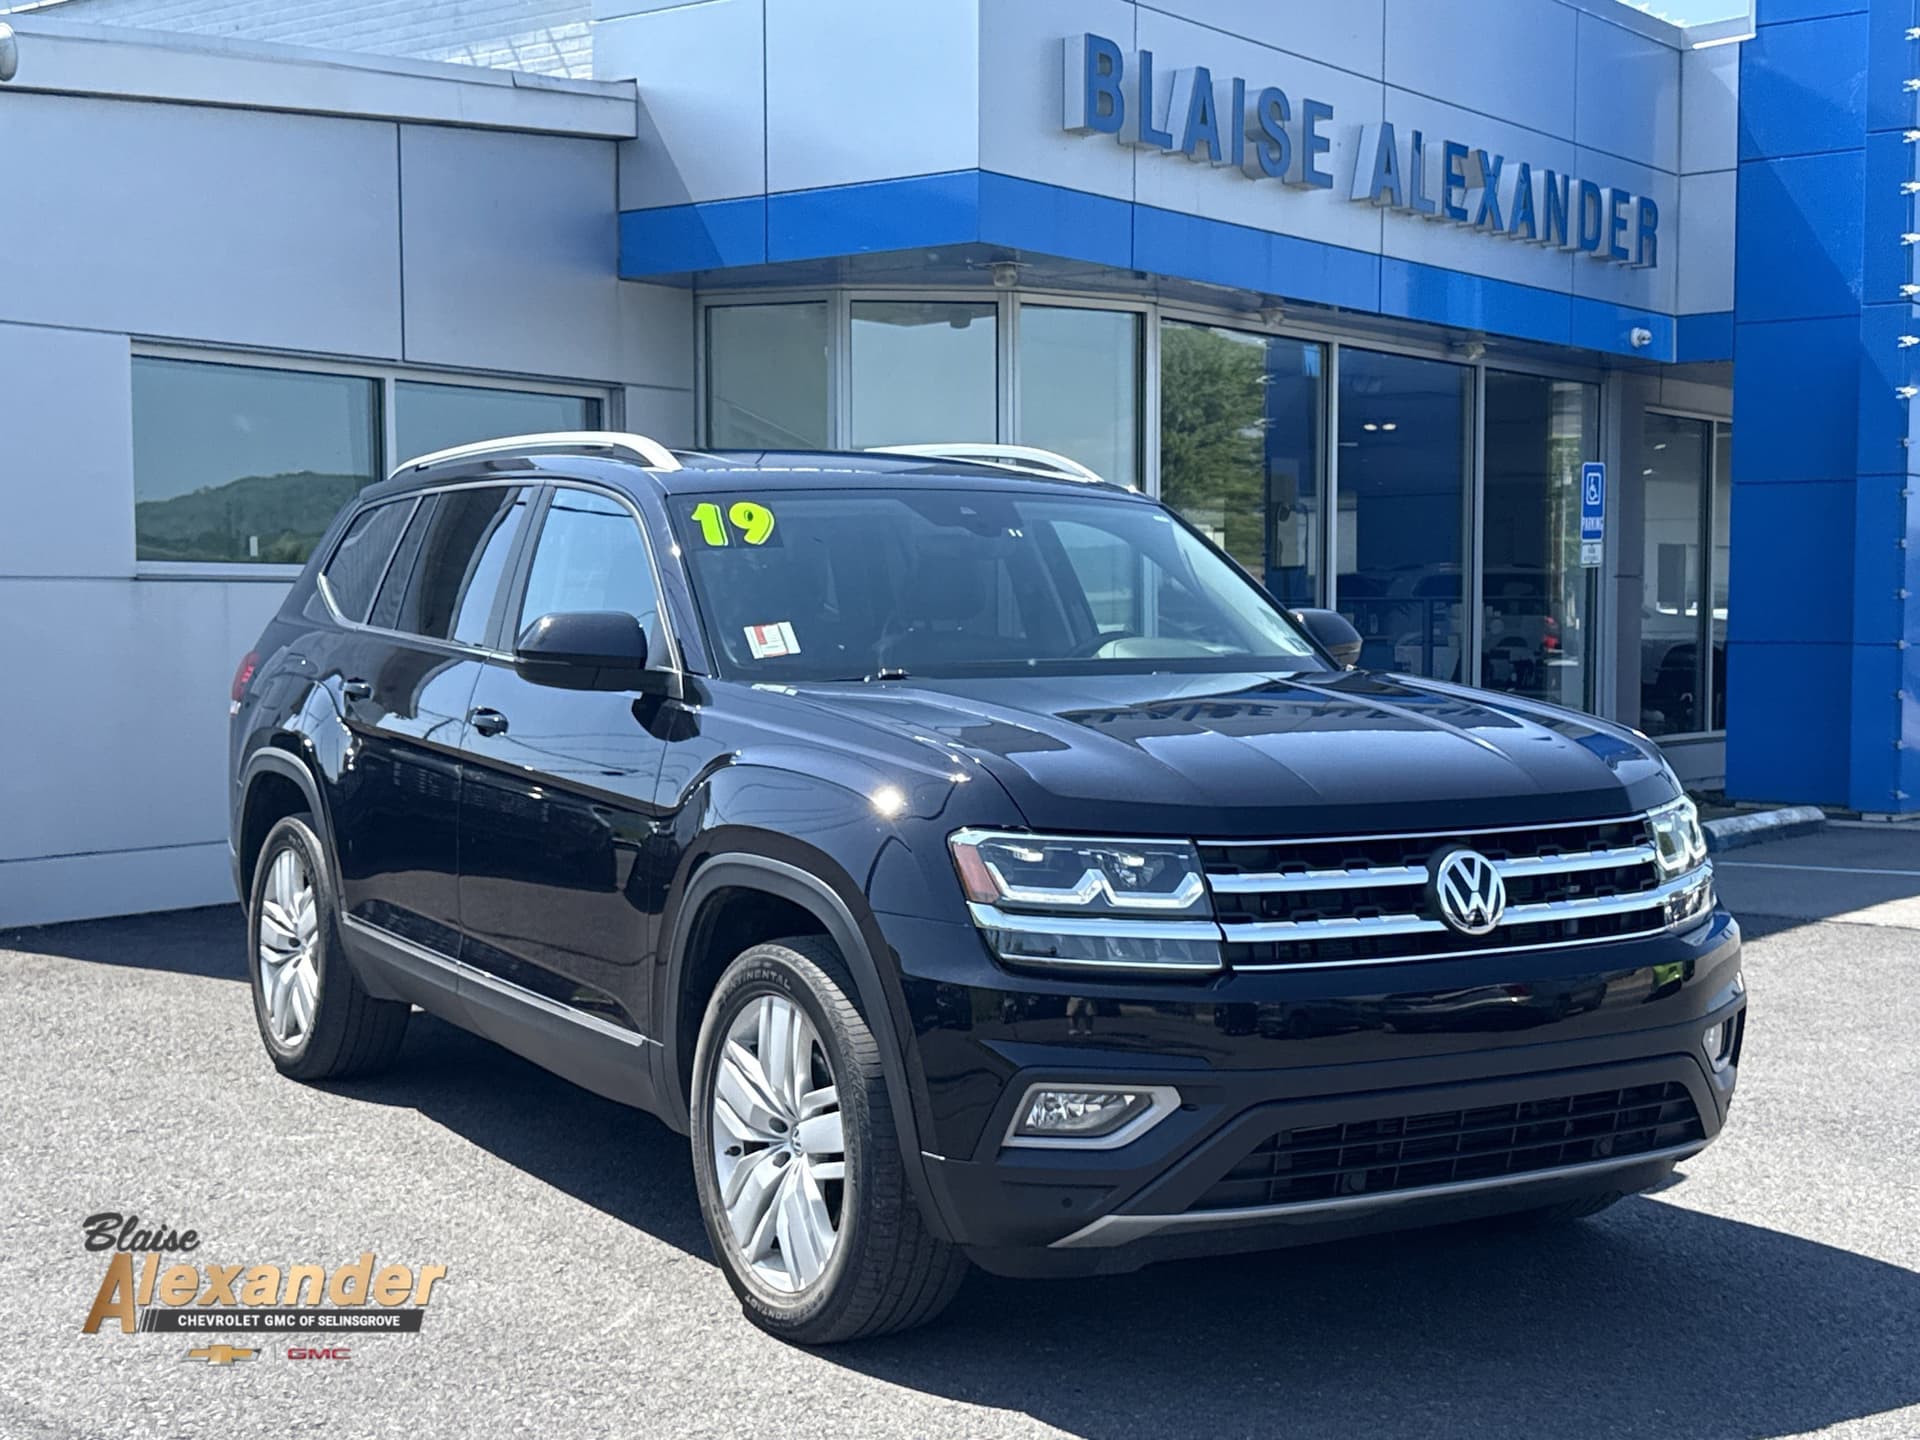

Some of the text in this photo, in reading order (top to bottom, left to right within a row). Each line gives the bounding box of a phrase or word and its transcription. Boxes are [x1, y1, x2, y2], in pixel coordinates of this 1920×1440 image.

[1078, 32, 1658, 268] BLAISE ALEXANDER
[691, 502, 775, 546] 19
